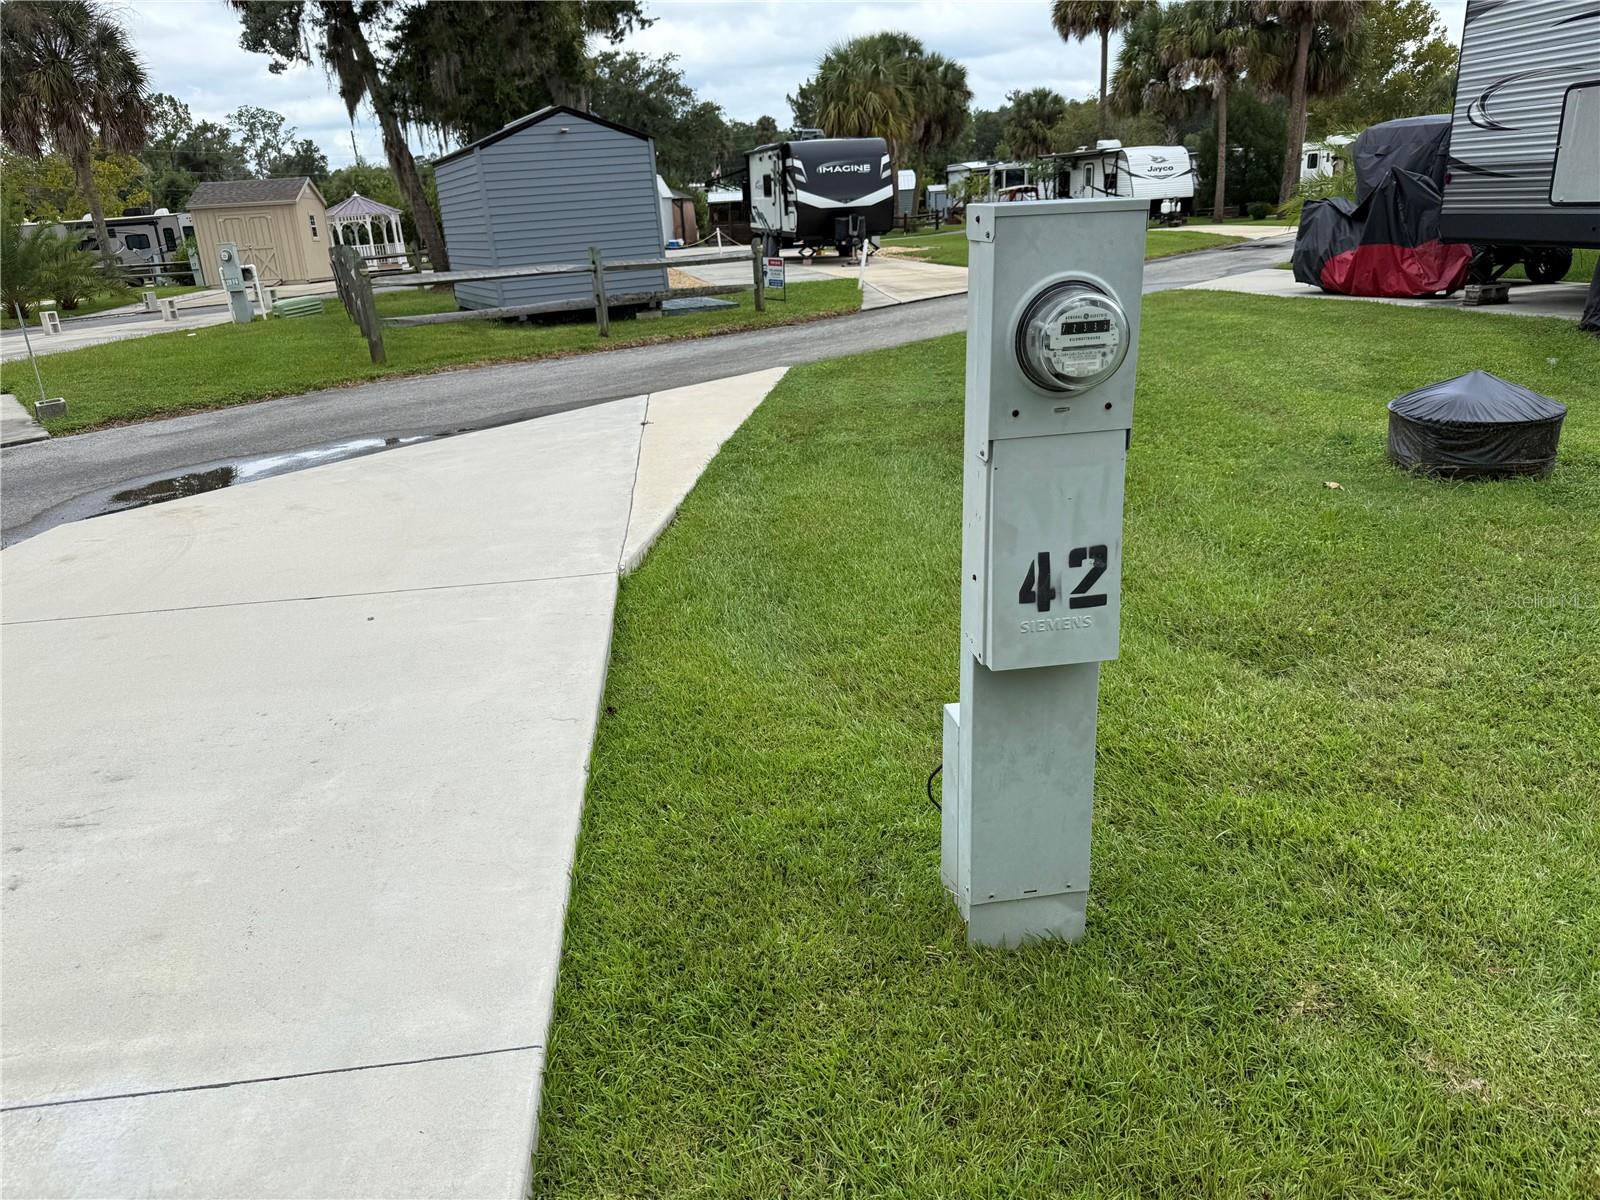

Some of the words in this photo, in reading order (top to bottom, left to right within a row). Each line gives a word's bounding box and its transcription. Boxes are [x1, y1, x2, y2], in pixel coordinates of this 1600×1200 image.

[818, 163, 872, 174] IMAGINE
[1147, 164, 1174, 173] Jayco
[1018, 544, 1108, 613] 42
[1020, 615, 1093, 634] SIEMENS
